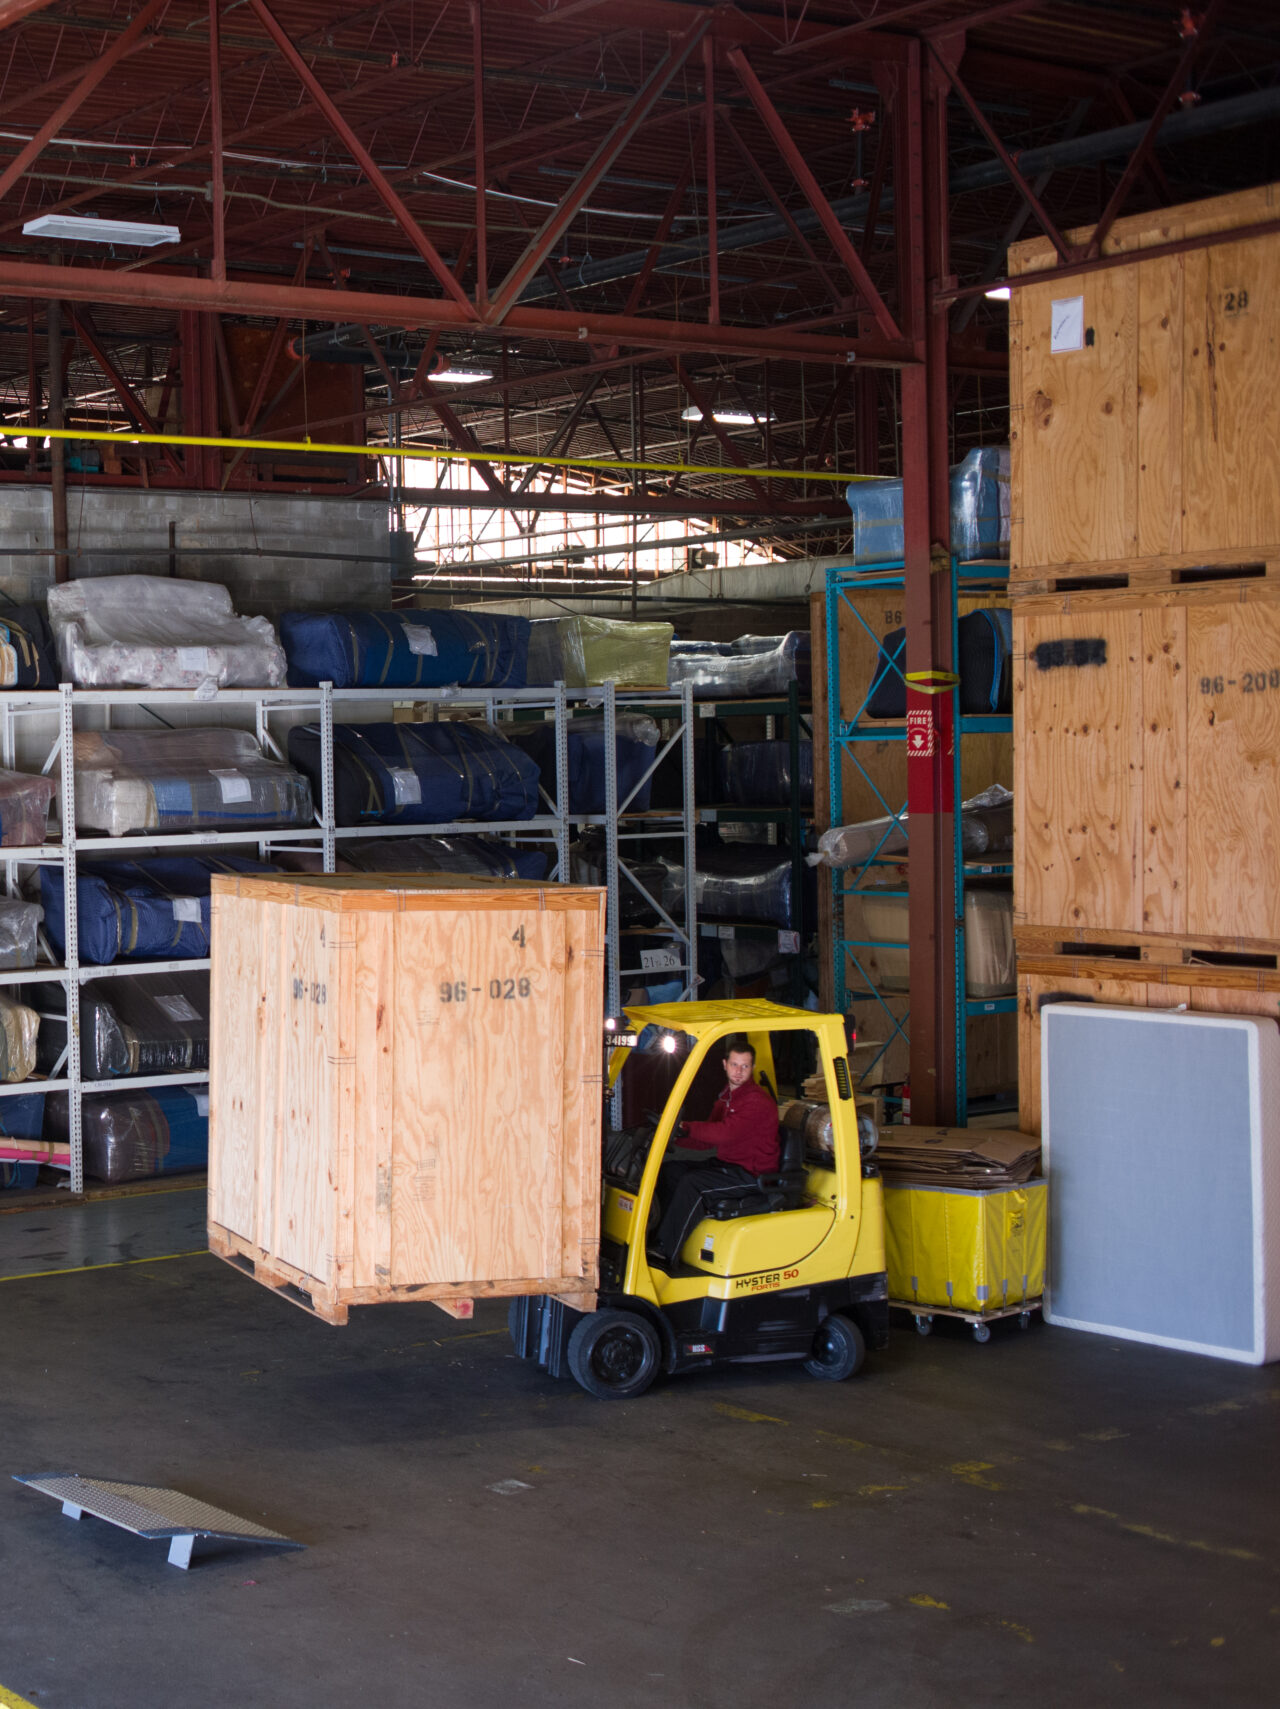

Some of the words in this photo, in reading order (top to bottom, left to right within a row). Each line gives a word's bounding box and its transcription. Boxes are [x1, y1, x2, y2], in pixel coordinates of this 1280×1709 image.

[909, 716, 927, 725] FIRE
[512, 924, 526, 948] 4
[643, 955, 655, 968] 21
[664, 954, 675, 967] 26
[293, 978, 327, 1005] 96-028
[439, 977, 531, 1003] 96-028
[735, 1273, 781, 1290] HYSTER
[782, 1268, 800, 1281] 50
[751, 1282, 781, 1292] FORTIS
